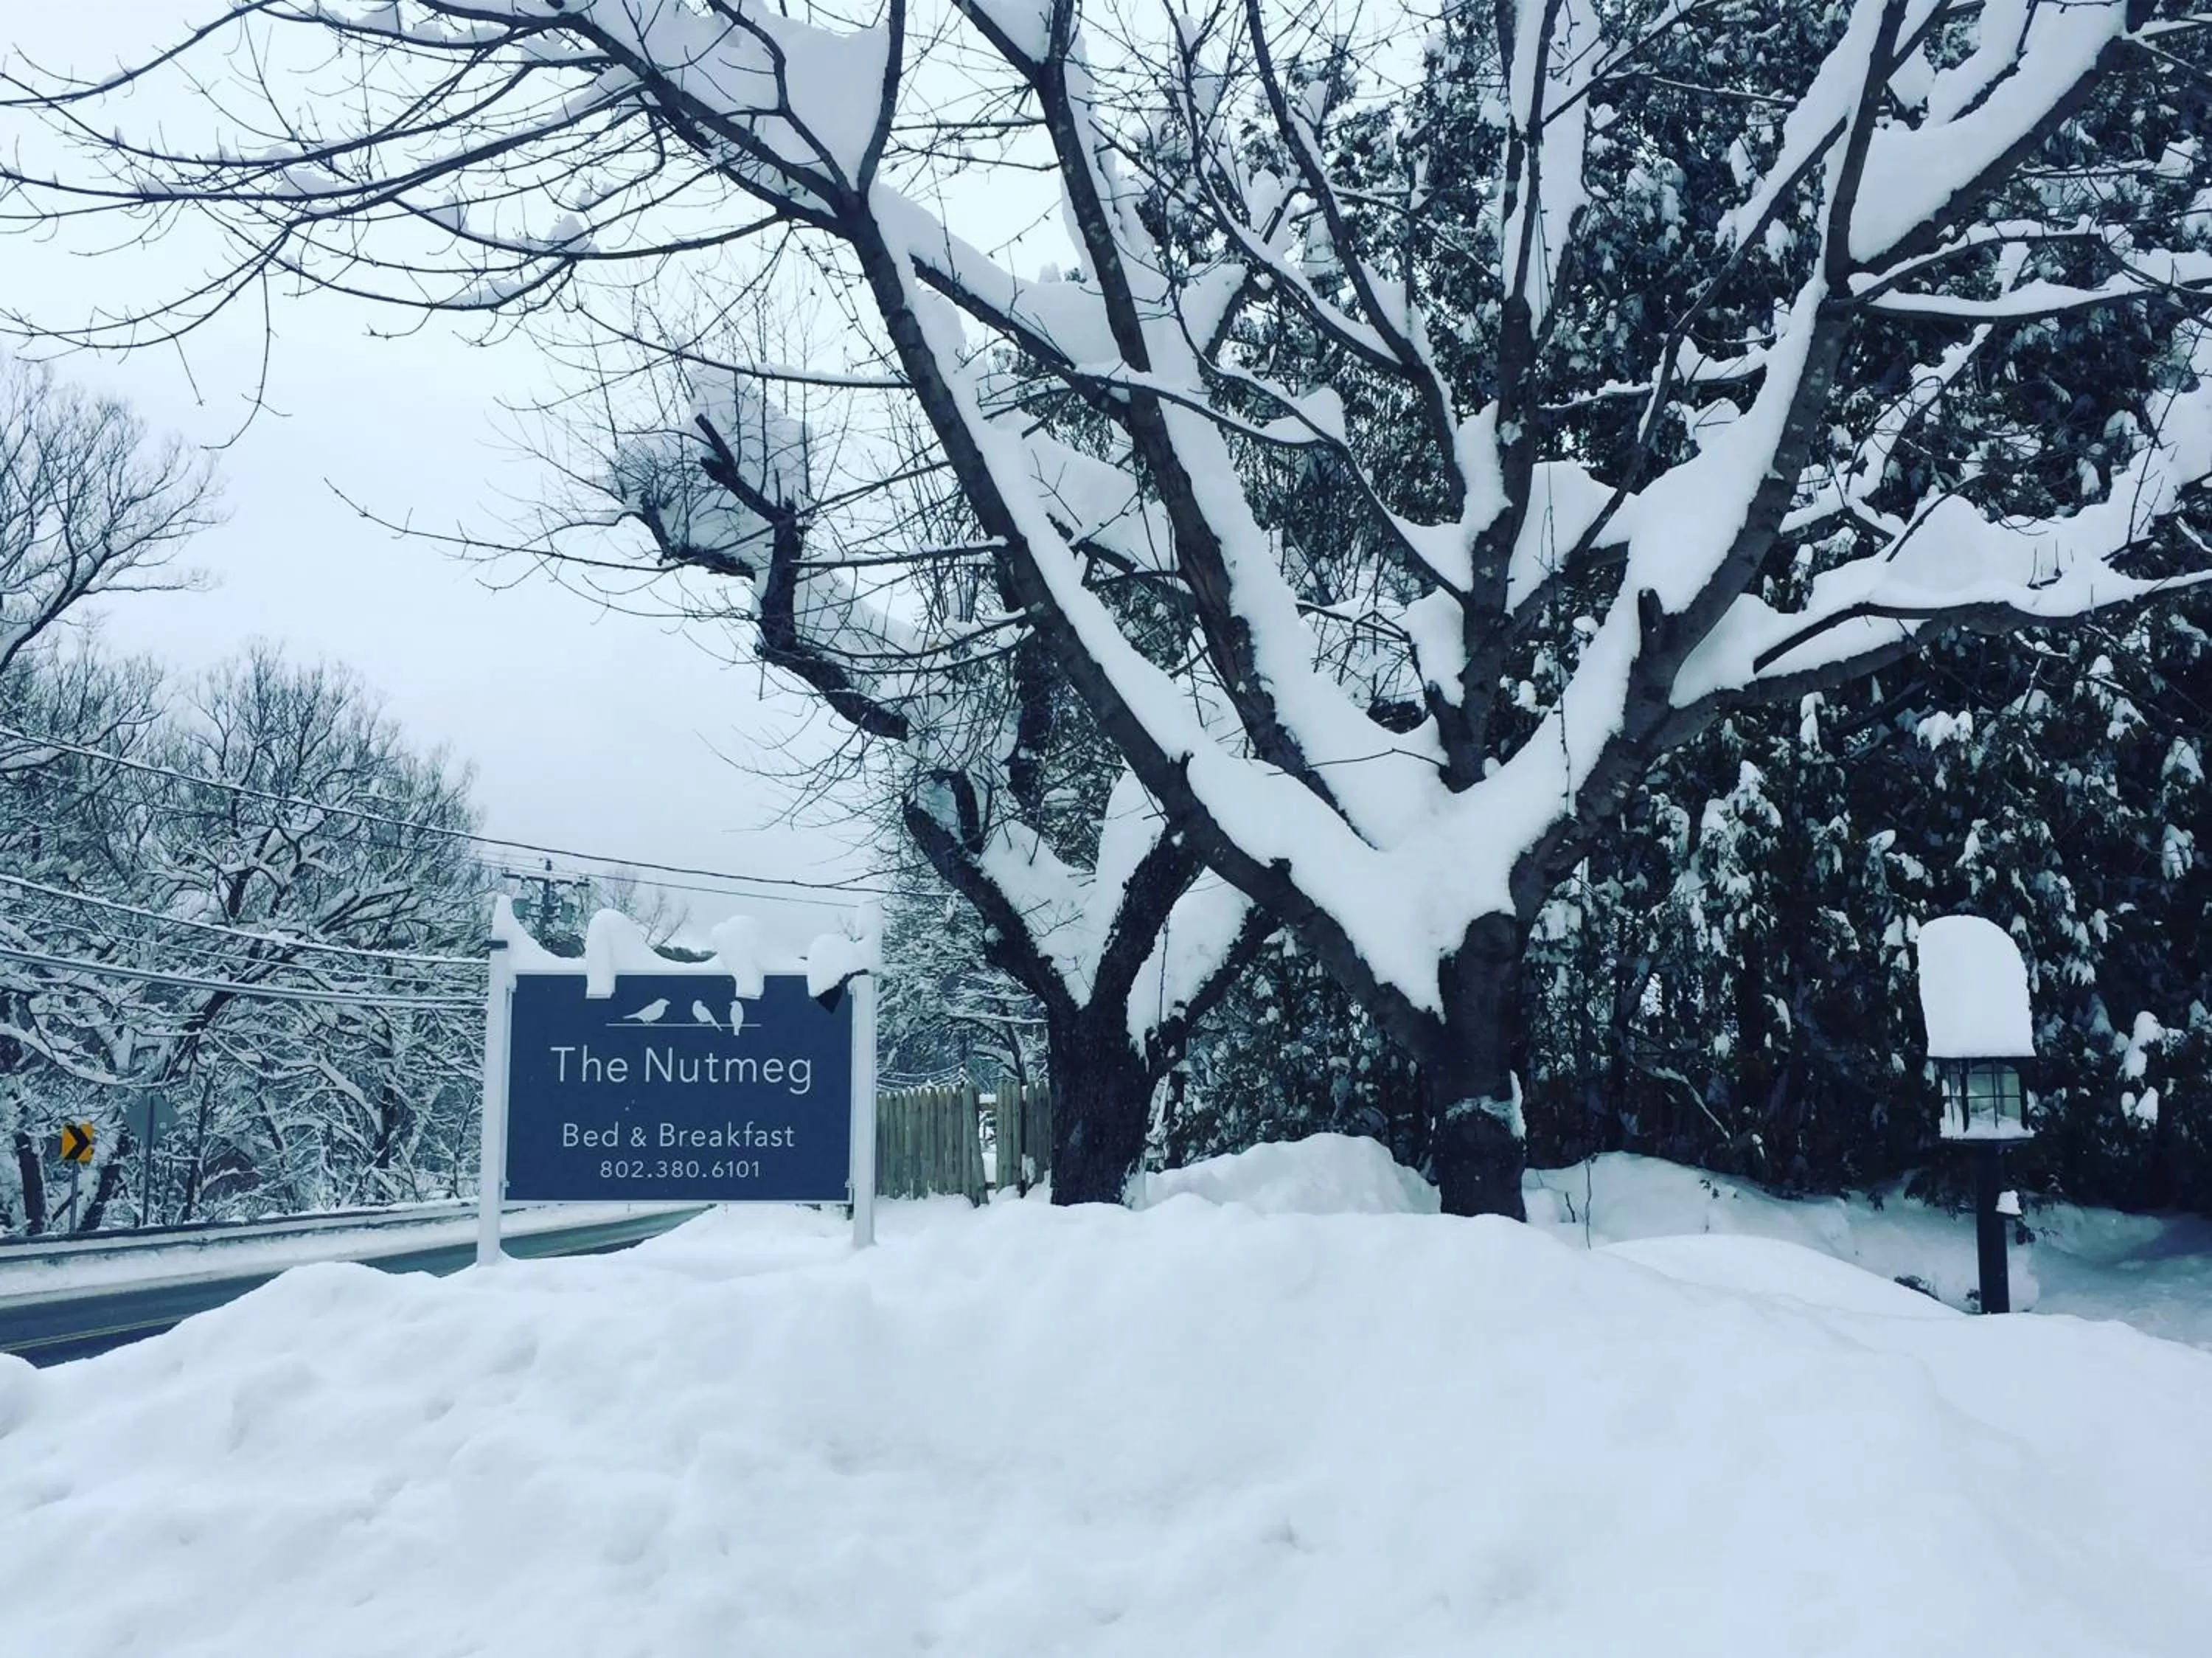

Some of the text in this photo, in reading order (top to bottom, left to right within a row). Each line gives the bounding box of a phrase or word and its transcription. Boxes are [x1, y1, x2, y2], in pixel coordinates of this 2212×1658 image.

[550, 1045, 811, 1095] The Nutmeg
[563, 1121, 795, 1147] Bed & Breakfast
[600, 1160, 759, 1178] 802.380.6101
